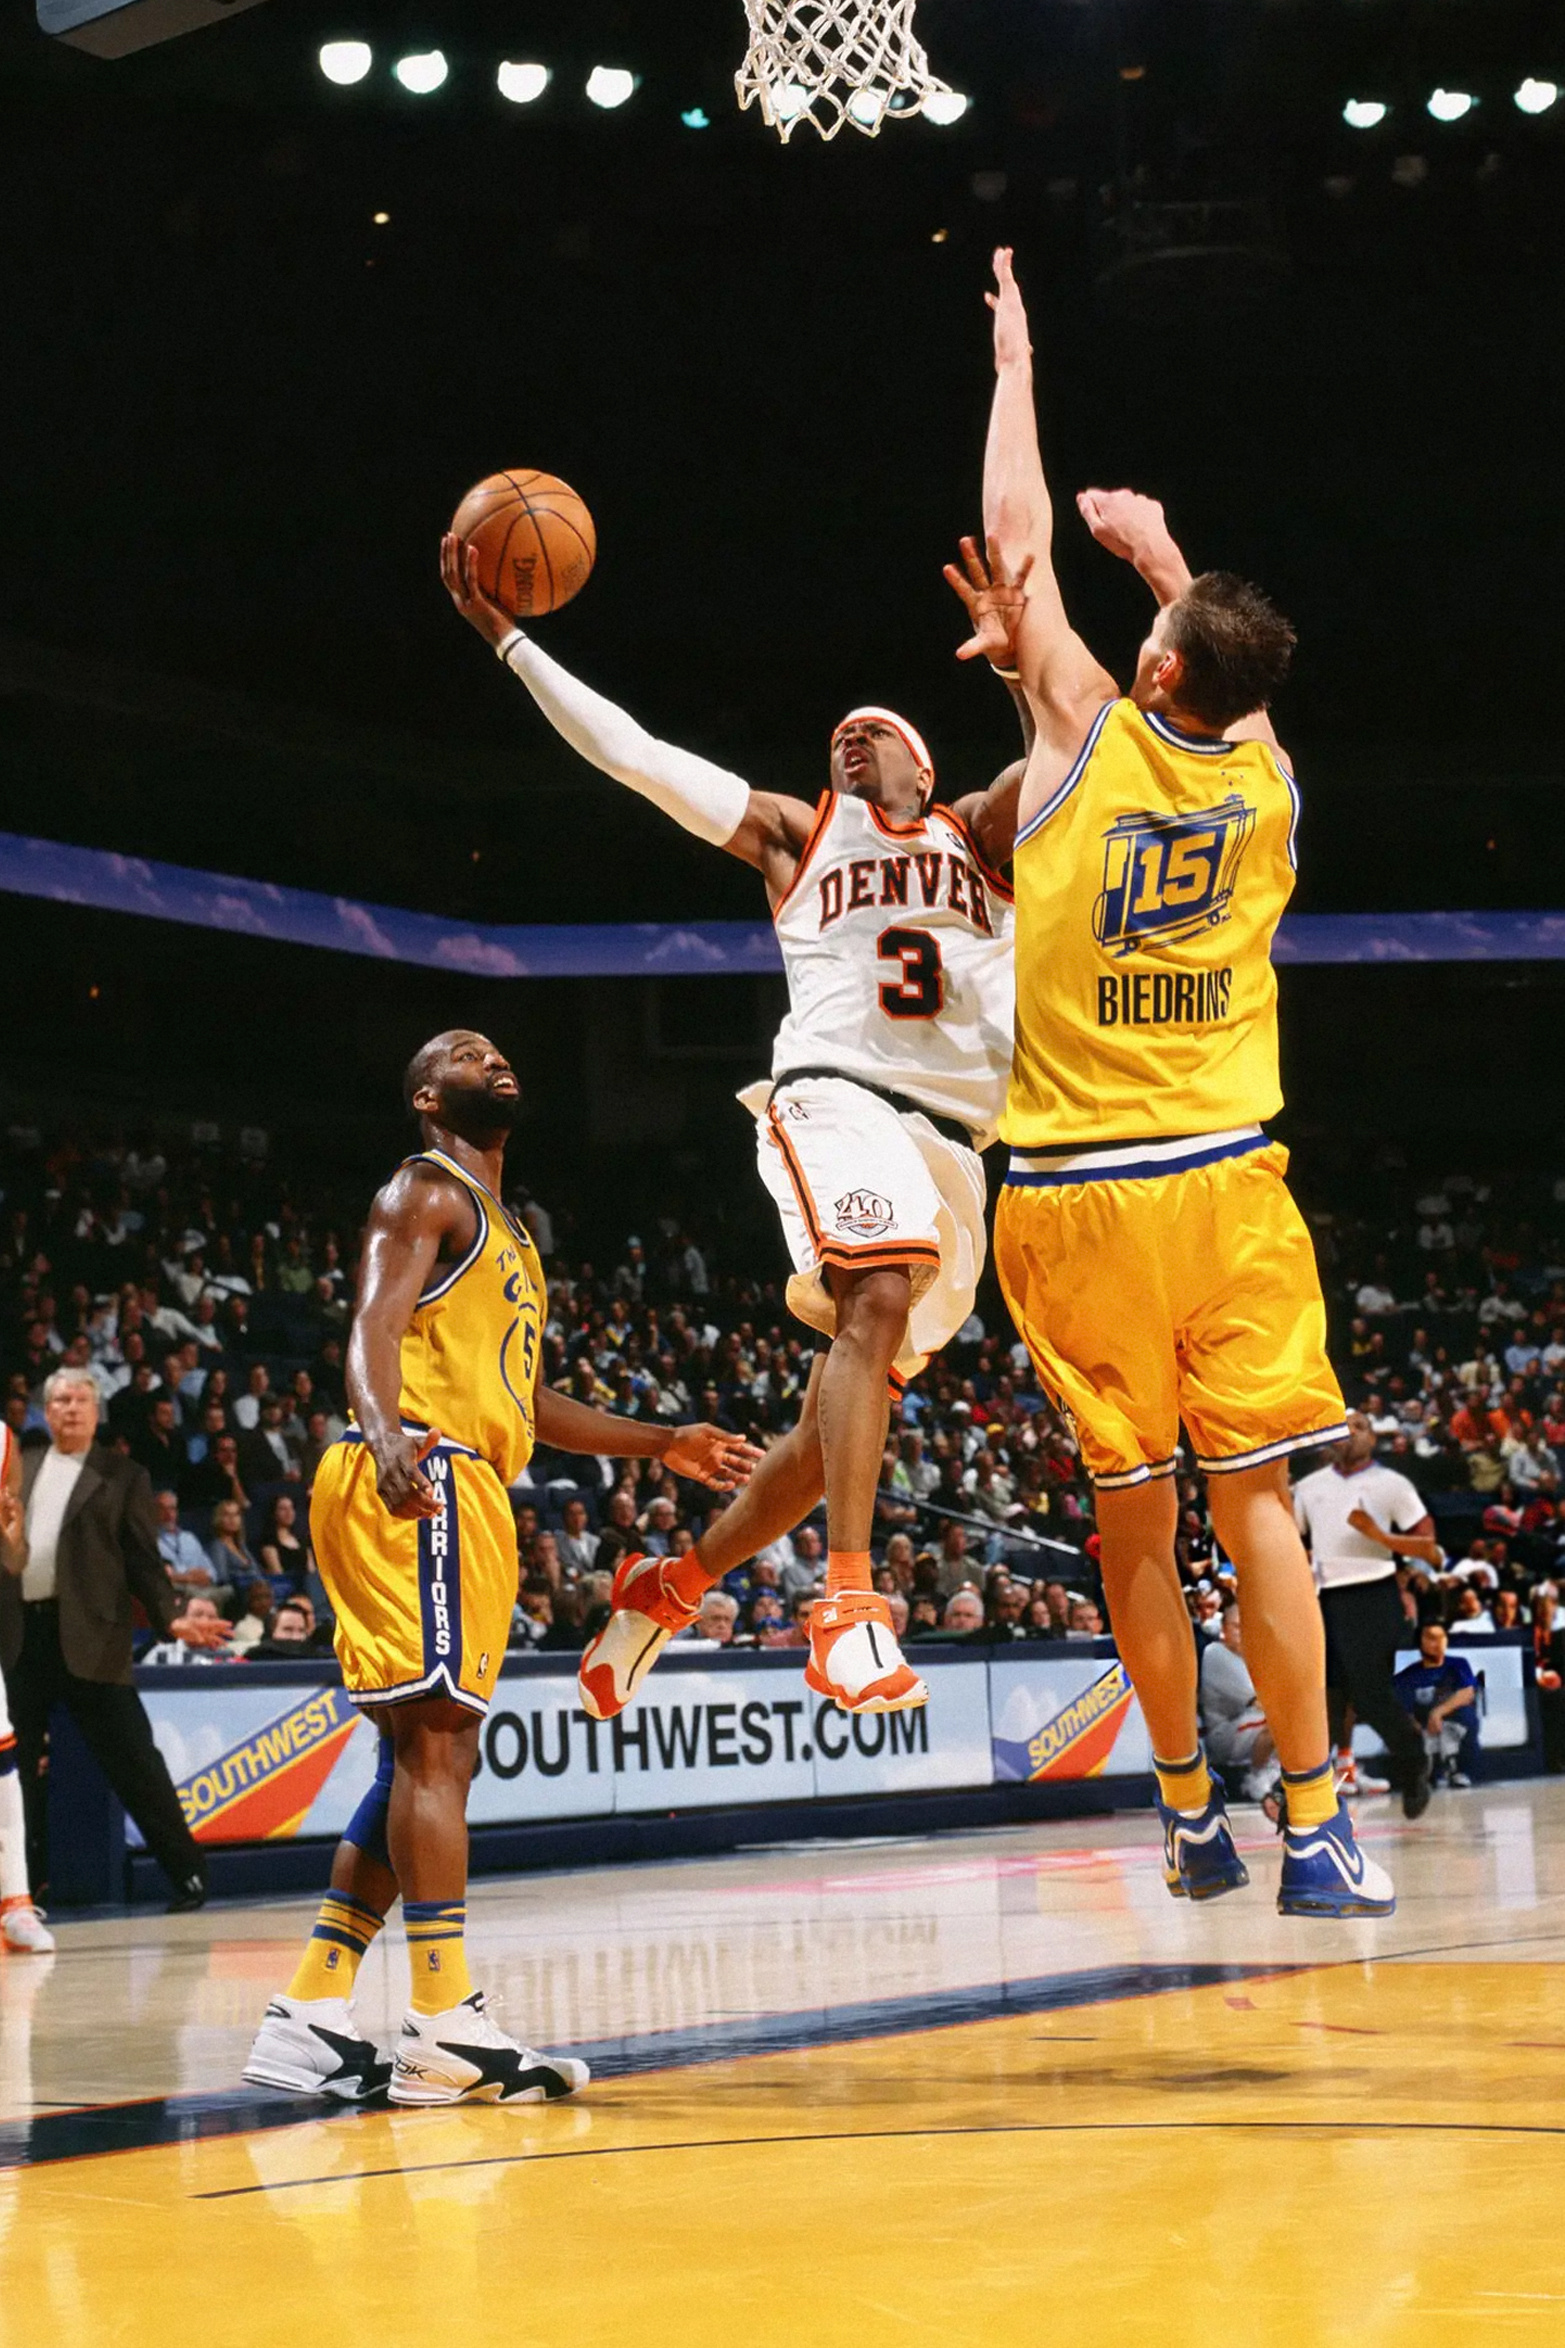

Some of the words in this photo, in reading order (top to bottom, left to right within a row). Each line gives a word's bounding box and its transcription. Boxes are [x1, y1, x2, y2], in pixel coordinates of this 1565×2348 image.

[819, 852, 994, 938] DENVER
[1133, 831, 1217, 915] 15
[877, 926, 944, 1020] 3
[1097, 967, 1233, 1026] BIEDRINS
[523, 1320, 536, 1380] 5
[427, 1456, 451, 1656] WARRIORS
[176, 1688, 339, 1823] SOUTHWEST
[472, 1698, 930, 1781] OUTHWEST.COM
